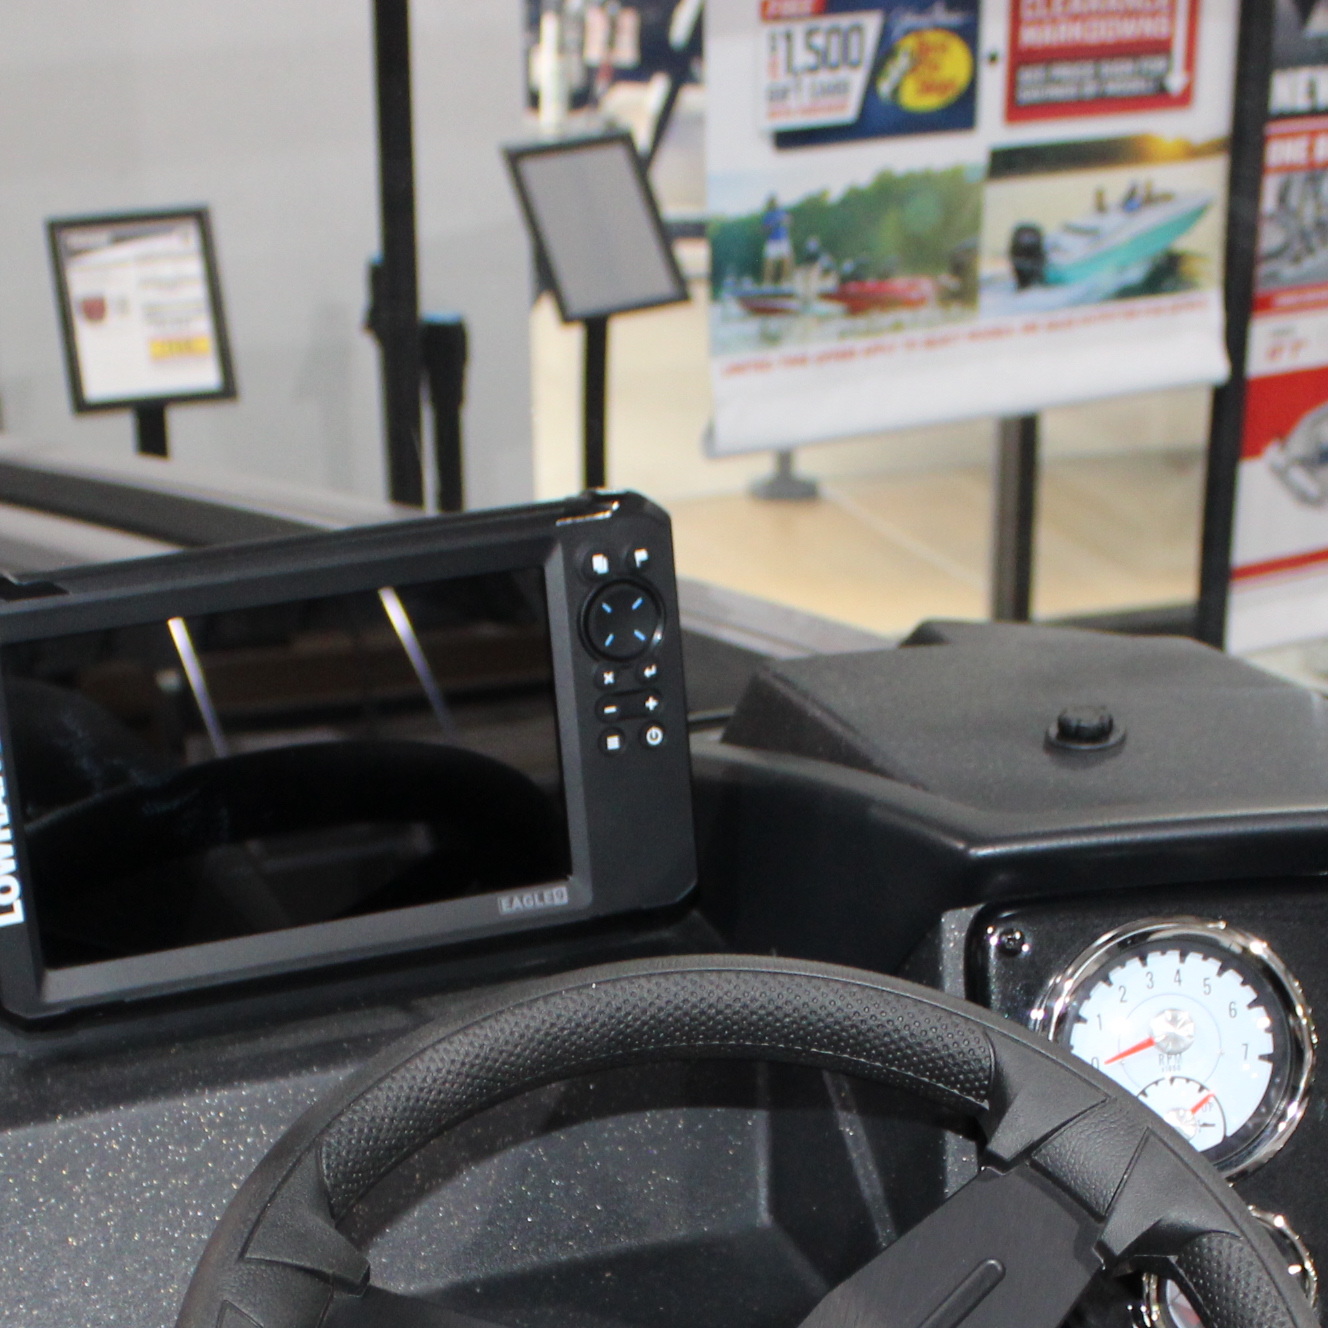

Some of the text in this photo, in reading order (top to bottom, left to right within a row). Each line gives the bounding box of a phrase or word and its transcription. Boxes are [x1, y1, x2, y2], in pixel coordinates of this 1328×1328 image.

[1145, 971, 1154, 989] 3
[1173, 969, 1183, 987] 4
[1202, 977, 1212, 996] 5
[1118, 985, 1128, 1004] 2
[1228, 1000, 1238, 1019] 6
[1096, 1013, 1103, 1031] 1
[1158, 1053, 1183, 1067] RPM
[1241, 1043, 1249, 1061] 7
